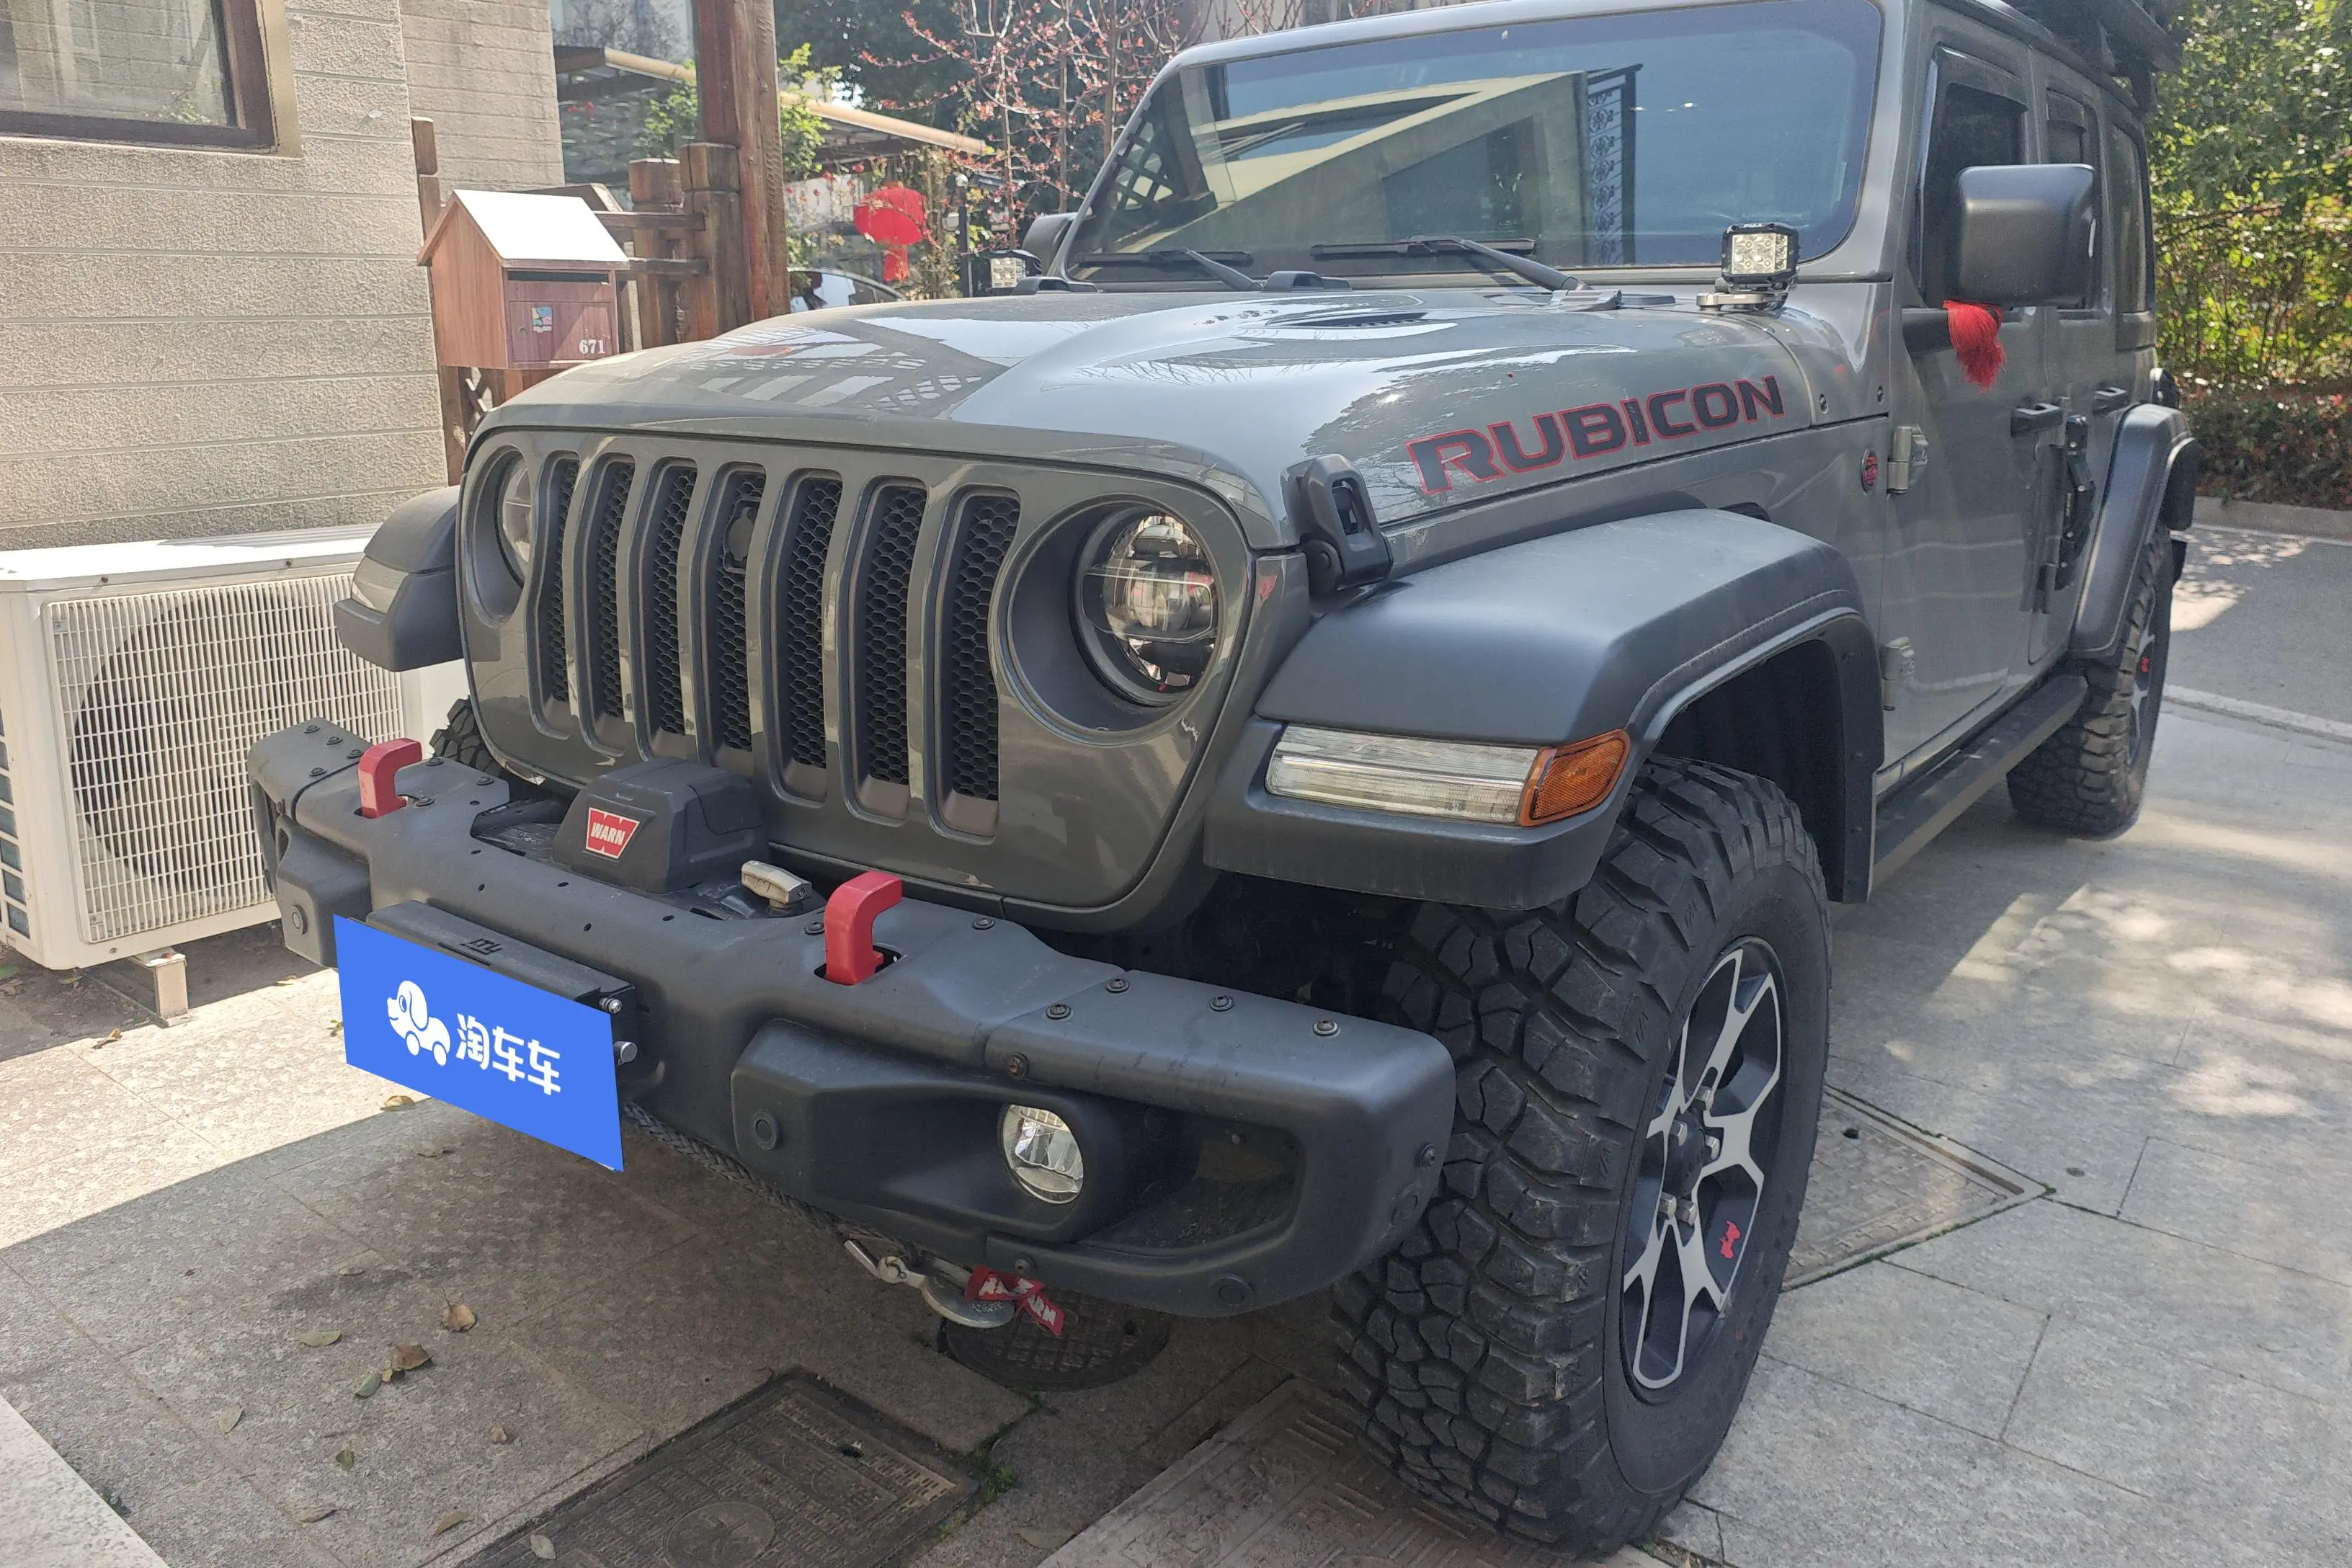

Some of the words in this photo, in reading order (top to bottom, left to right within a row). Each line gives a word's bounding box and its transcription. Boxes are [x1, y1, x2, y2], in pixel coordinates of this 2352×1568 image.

[579, 339, 605, 354] 671
[1406, 375, 1785, 494] RUBICON
[591, 822, 626, 846] WARN
